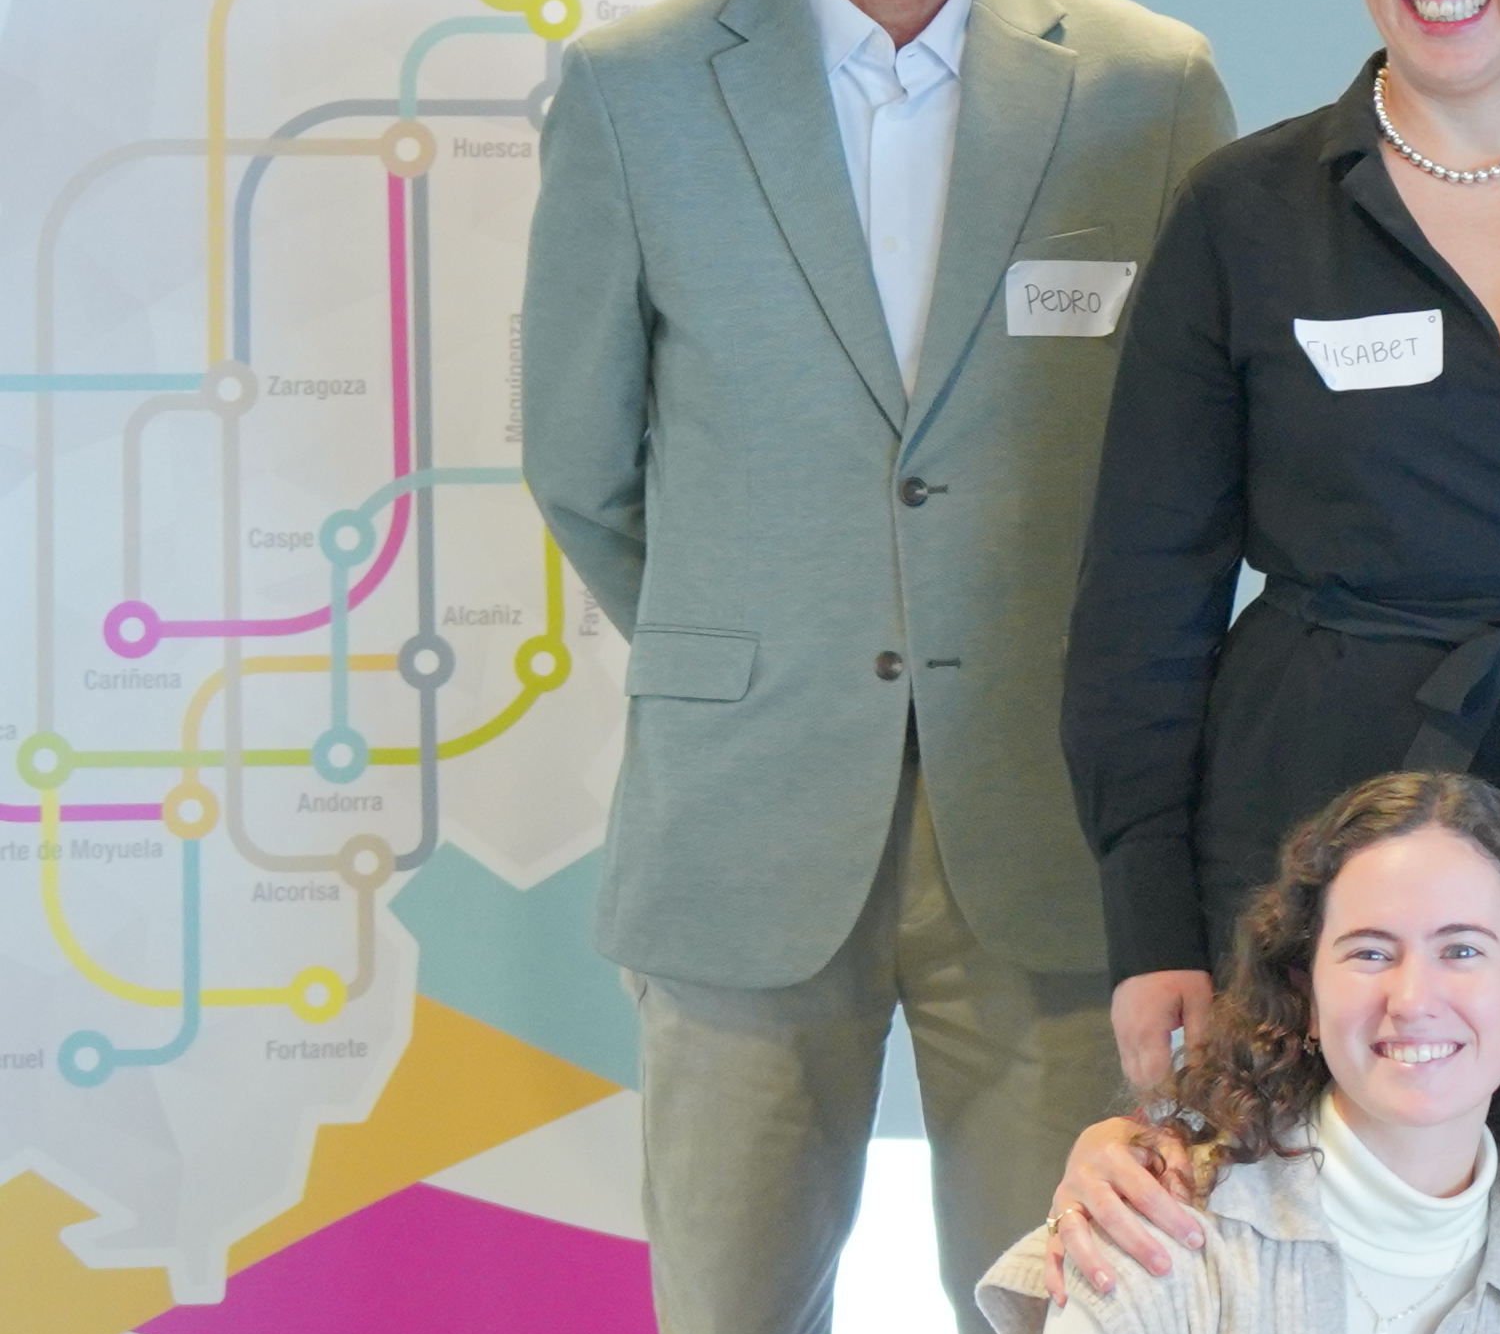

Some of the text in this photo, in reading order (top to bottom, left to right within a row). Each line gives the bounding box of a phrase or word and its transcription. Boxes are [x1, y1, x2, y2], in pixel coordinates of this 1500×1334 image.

[453, 137, 533, 158] Huesca
[267, 376, 366, 400] Zaragoza
[248, 528, 314, 552] Caspe
[442, 604, 523, 627] Alcañiz
[83, 668, 182, 691] Cariñena
[297, 793, 384, 814] Andorra
[70, 839, 164, 863] Moyuela
[251, 881, 341, 903] Alcorisa
[0, 1048, 45, 1069] ruel
[265, 1038, 369, 1061] Fortanete
